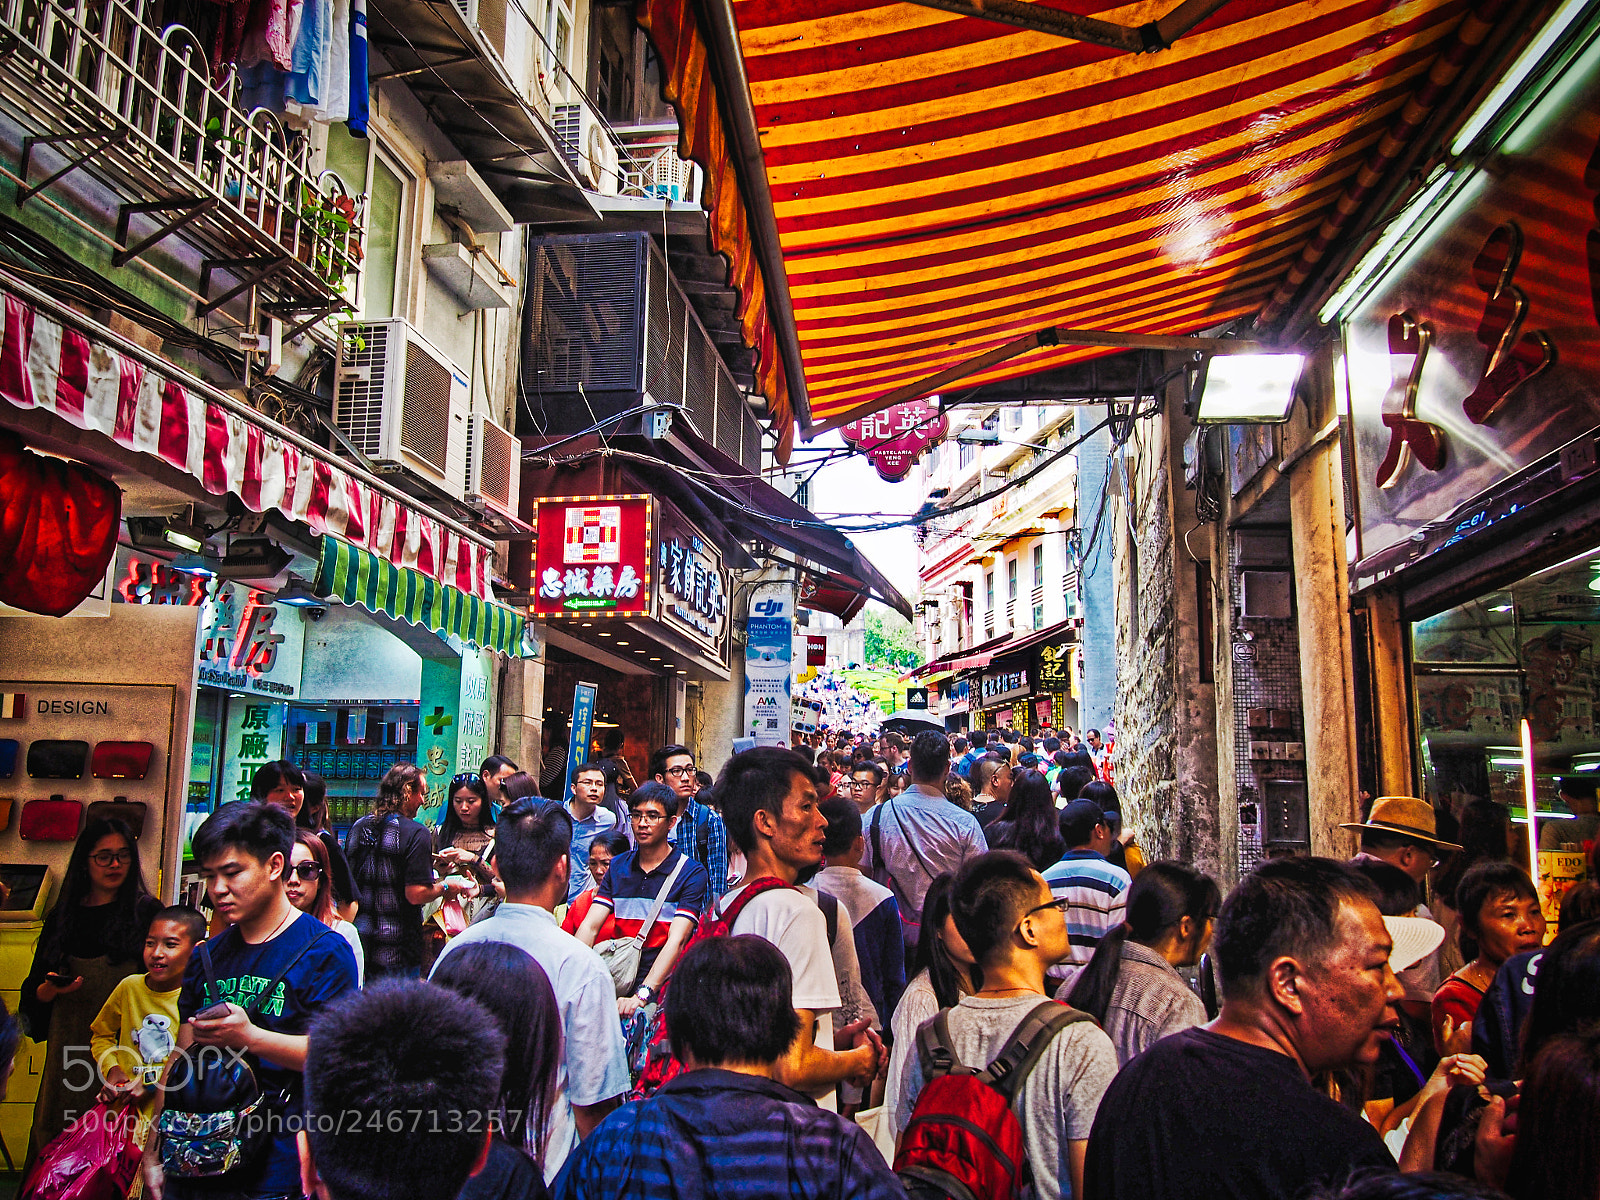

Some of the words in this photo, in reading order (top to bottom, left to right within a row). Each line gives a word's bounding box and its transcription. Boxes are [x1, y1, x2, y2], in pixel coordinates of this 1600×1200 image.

[539, 565, 642, 598] 忠誠藥房
[38, 700, 108, 714] DESIGN
[1557, 857, 1582, 867] EDO
